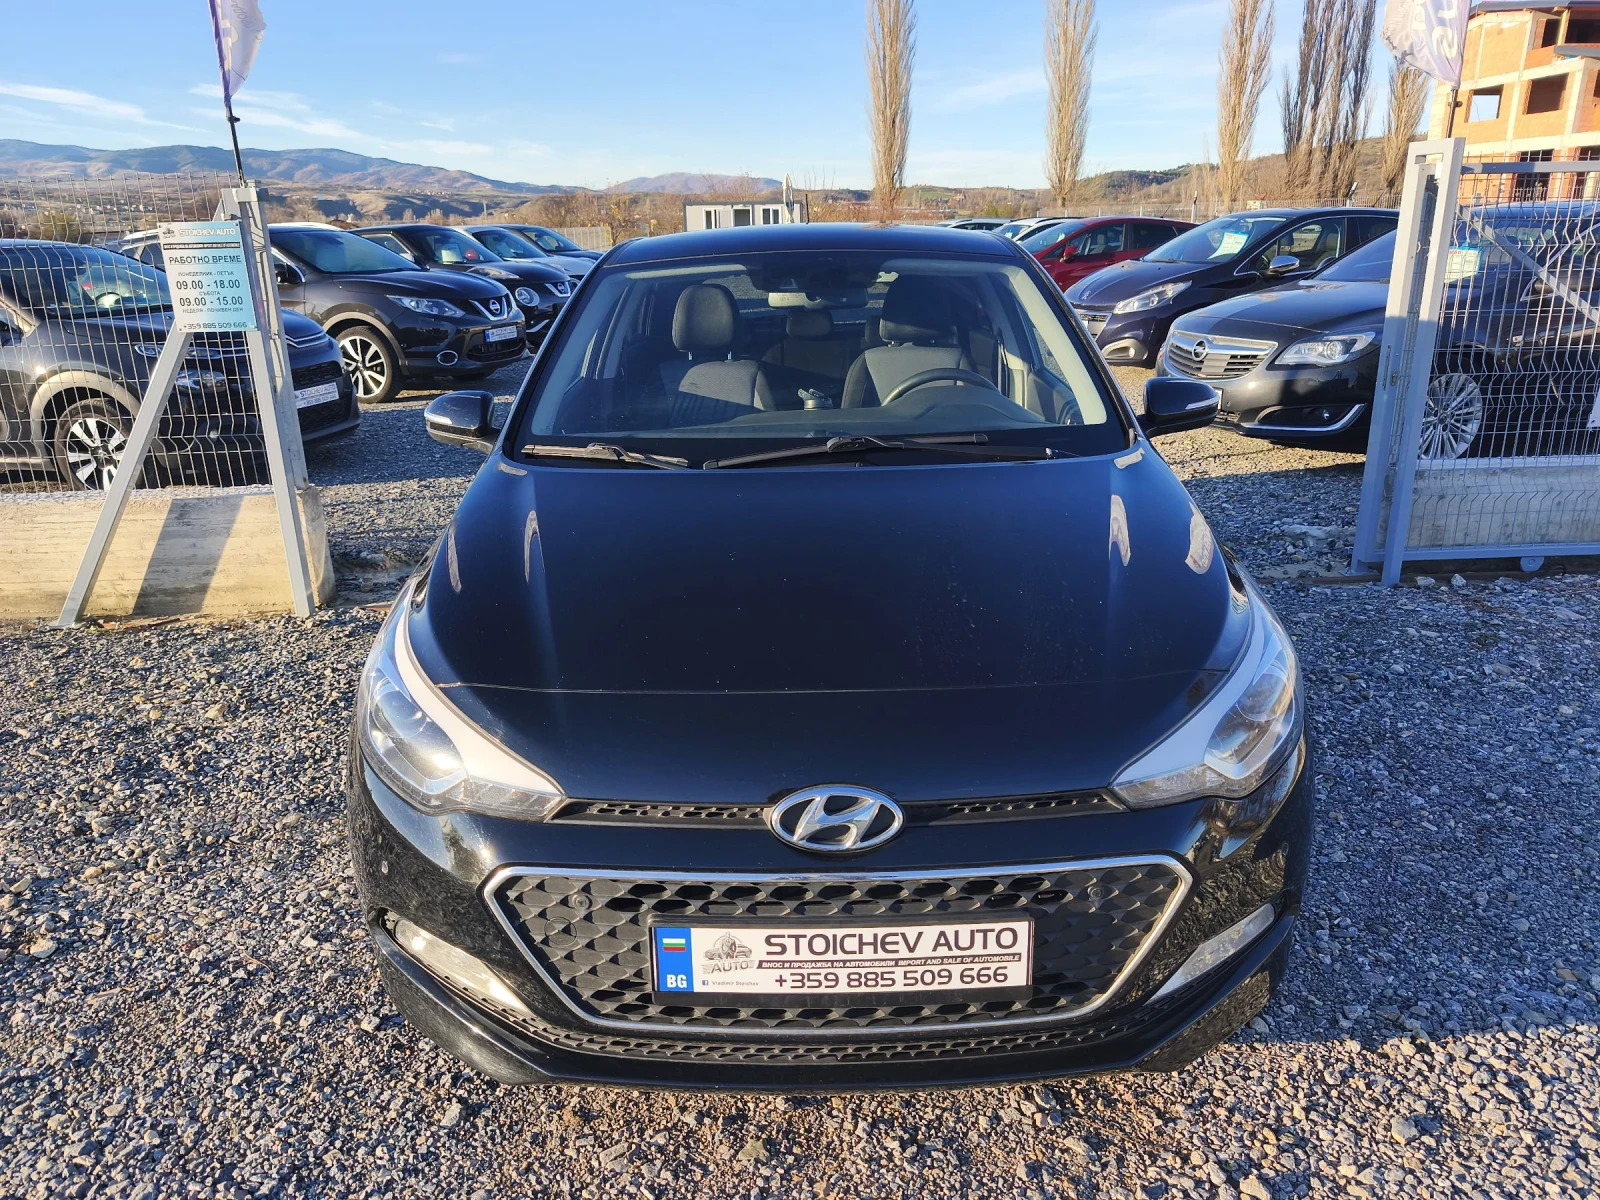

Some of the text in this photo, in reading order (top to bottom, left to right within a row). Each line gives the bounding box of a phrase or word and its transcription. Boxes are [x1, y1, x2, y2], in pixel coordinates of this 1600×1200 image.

[179, 228, 214, 237] STOICHEV
[216, 228, 236, 236] AUTO
[169, 255, 242, 264] РАБОТНО ВРЕМЕ
[176, 280, 204, 290] 09.00
[213, 279, 241, 289] 18.00
[179, 297, 207, 307] 09.00
[216, 296, 244, 306] 15.00
[764, 927, 1019, 956] STOICHEV AUTO
[973, 954, 1021, 963] AUTOMOBILE
[711, 960, 749, 974] AUTO
[791, 961, 832, 969] ПРОДАЖБА
[845, 960, 896, 968] АВТОМОБИЛИ
[666, 974, 688, 989] BG
[774, 966, 1009, 989] +359 885 509 666
